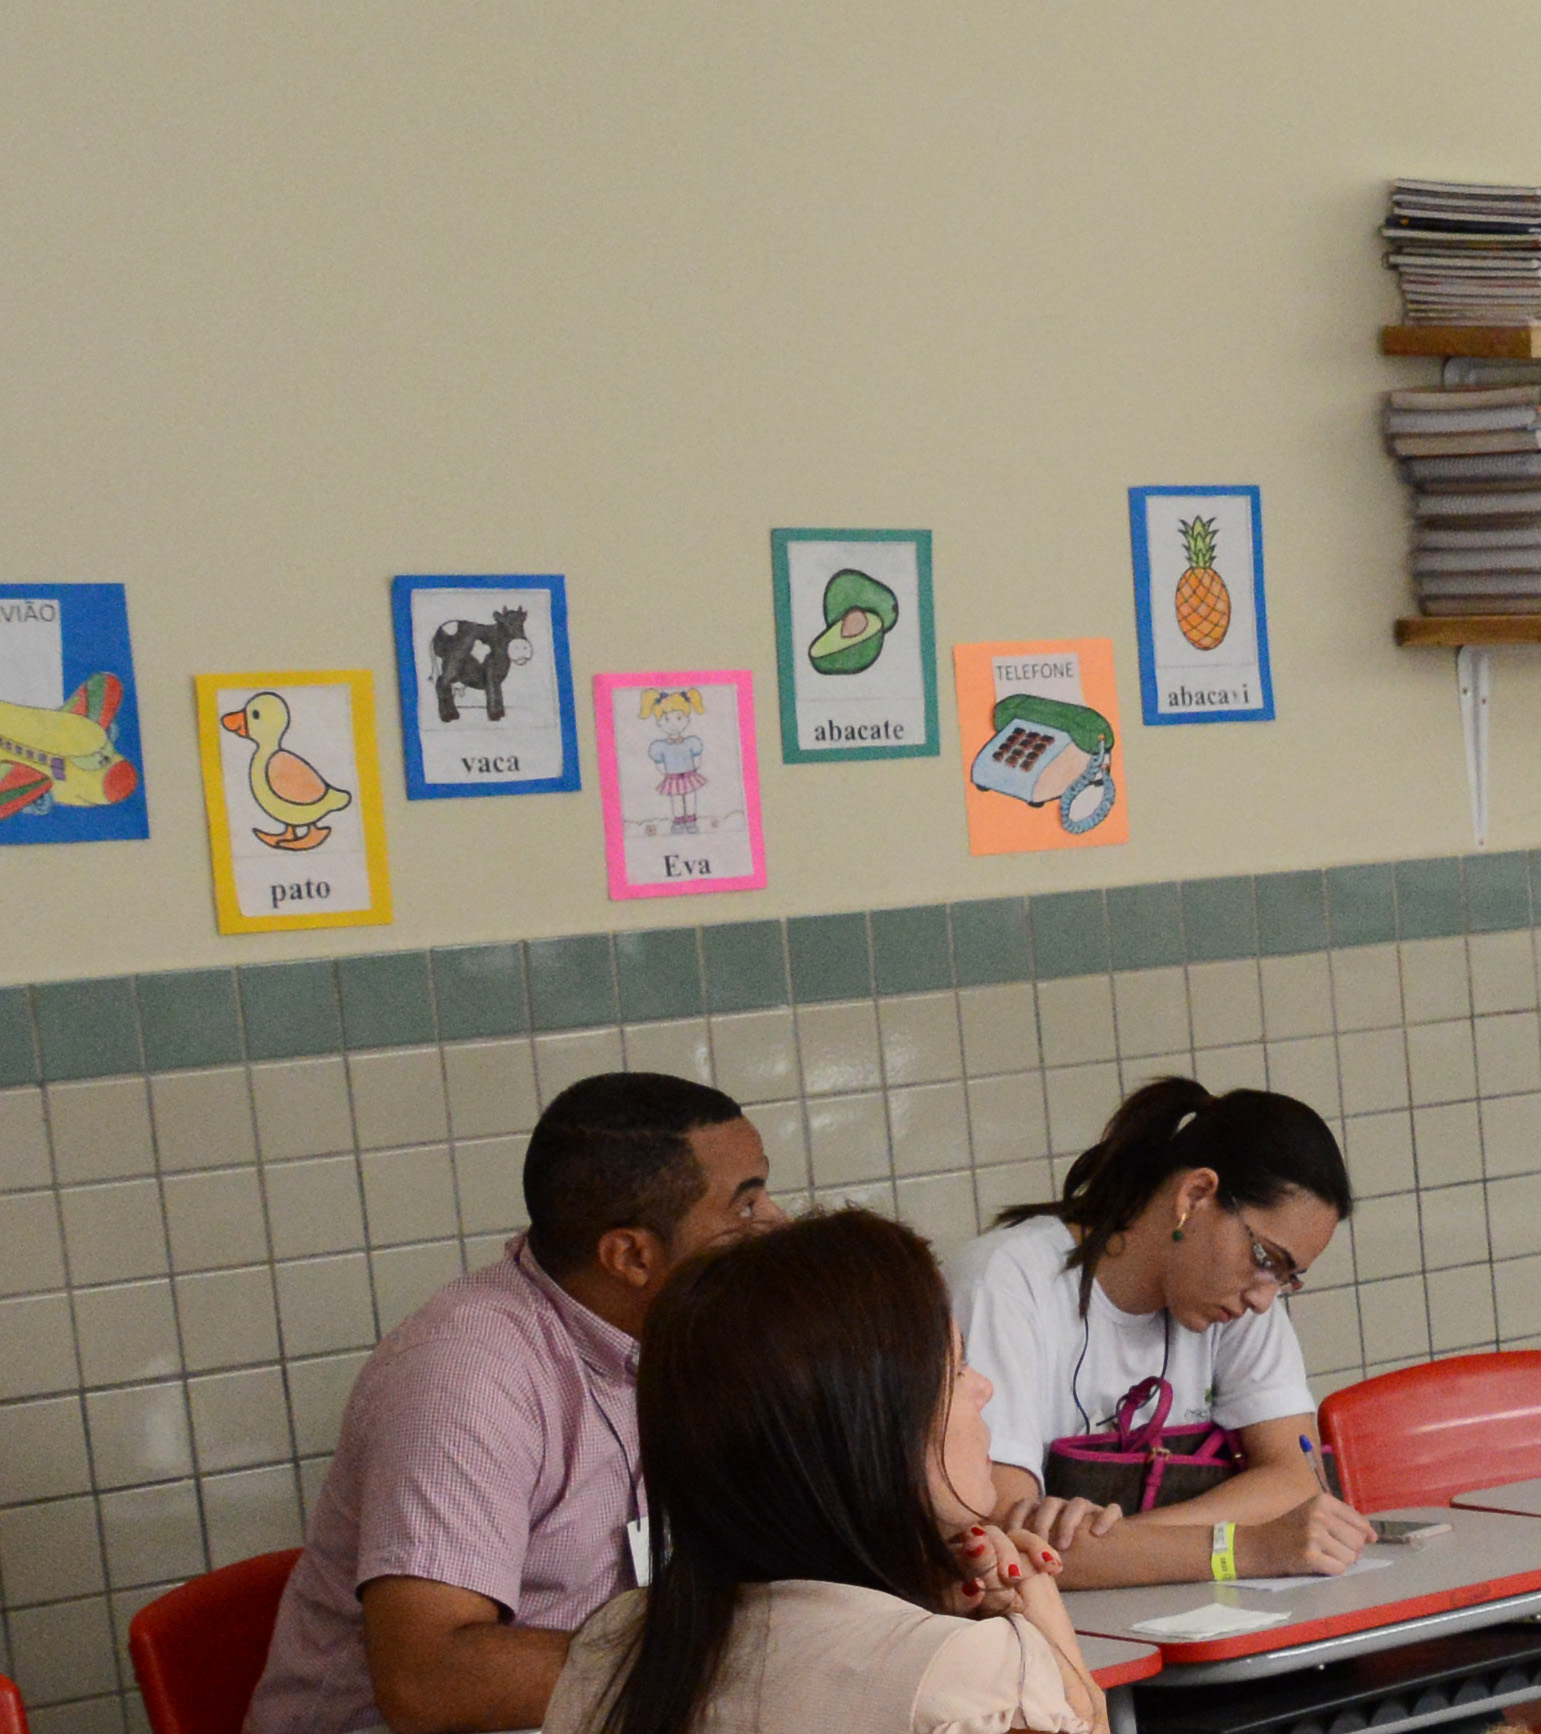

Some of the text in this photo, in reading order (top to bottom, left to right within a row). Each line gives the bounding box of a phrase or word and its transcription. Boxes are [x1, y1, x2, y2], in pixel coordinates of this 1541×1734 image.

[995, 662, 1075, 682] TELEFONE
[814, 717, 905, 742] abacate
[461, 752, 520, 775] vaca
[664, 853, 712, 879] Eva
[270, 877, 332, 909] pato
